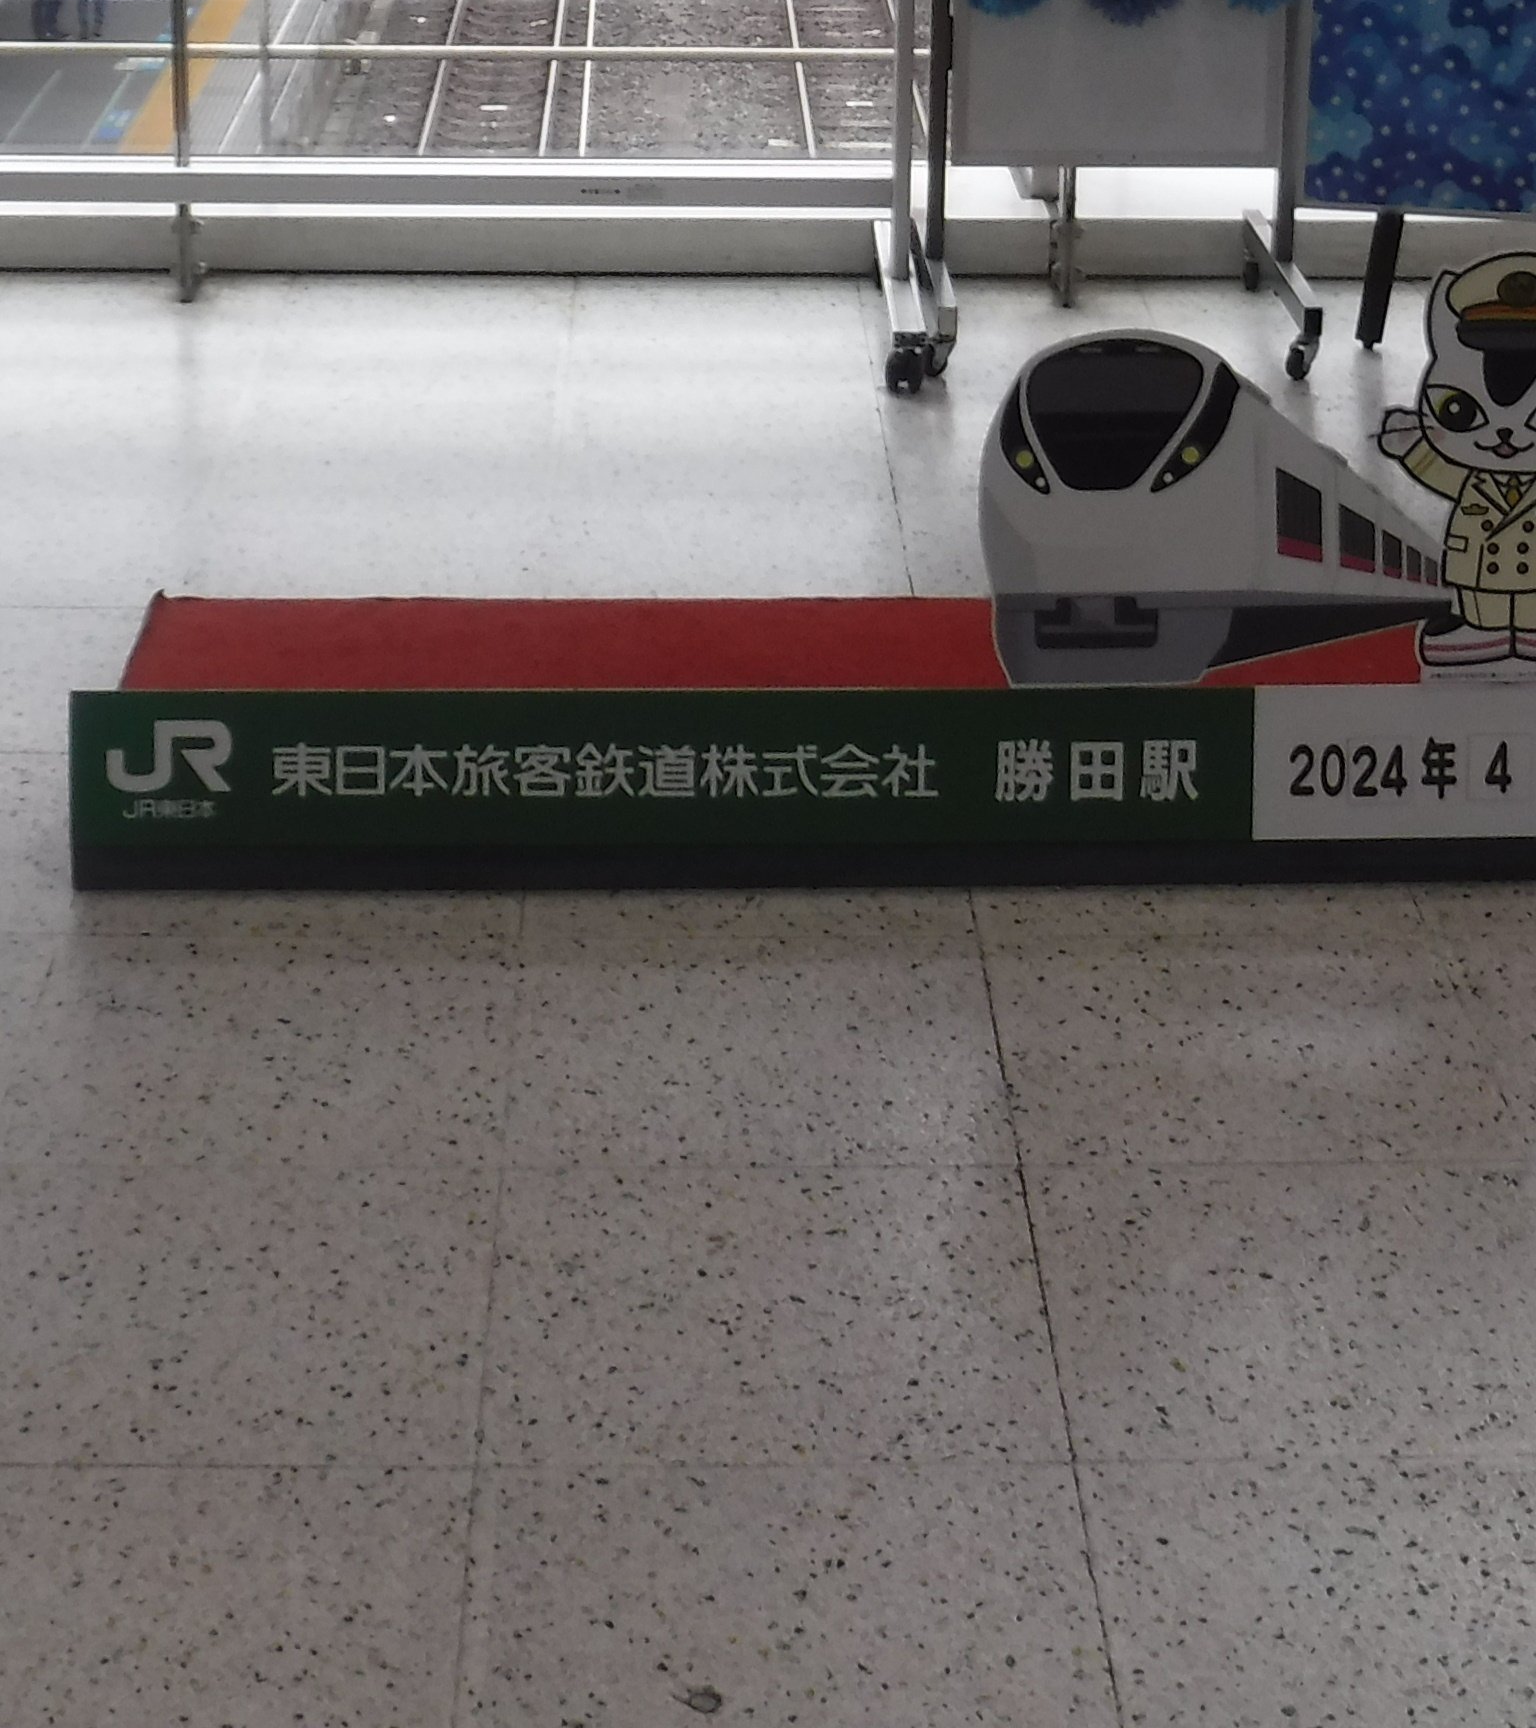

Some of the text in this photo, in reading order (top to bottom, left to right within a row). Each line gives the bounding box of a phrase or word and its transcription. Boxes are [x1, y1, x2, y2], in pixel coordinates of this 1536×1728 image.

[105, 719, 233, 793] JR
[272, 738, 1200, 804] 東日本旅客鉄道株式会社 勝田駅
